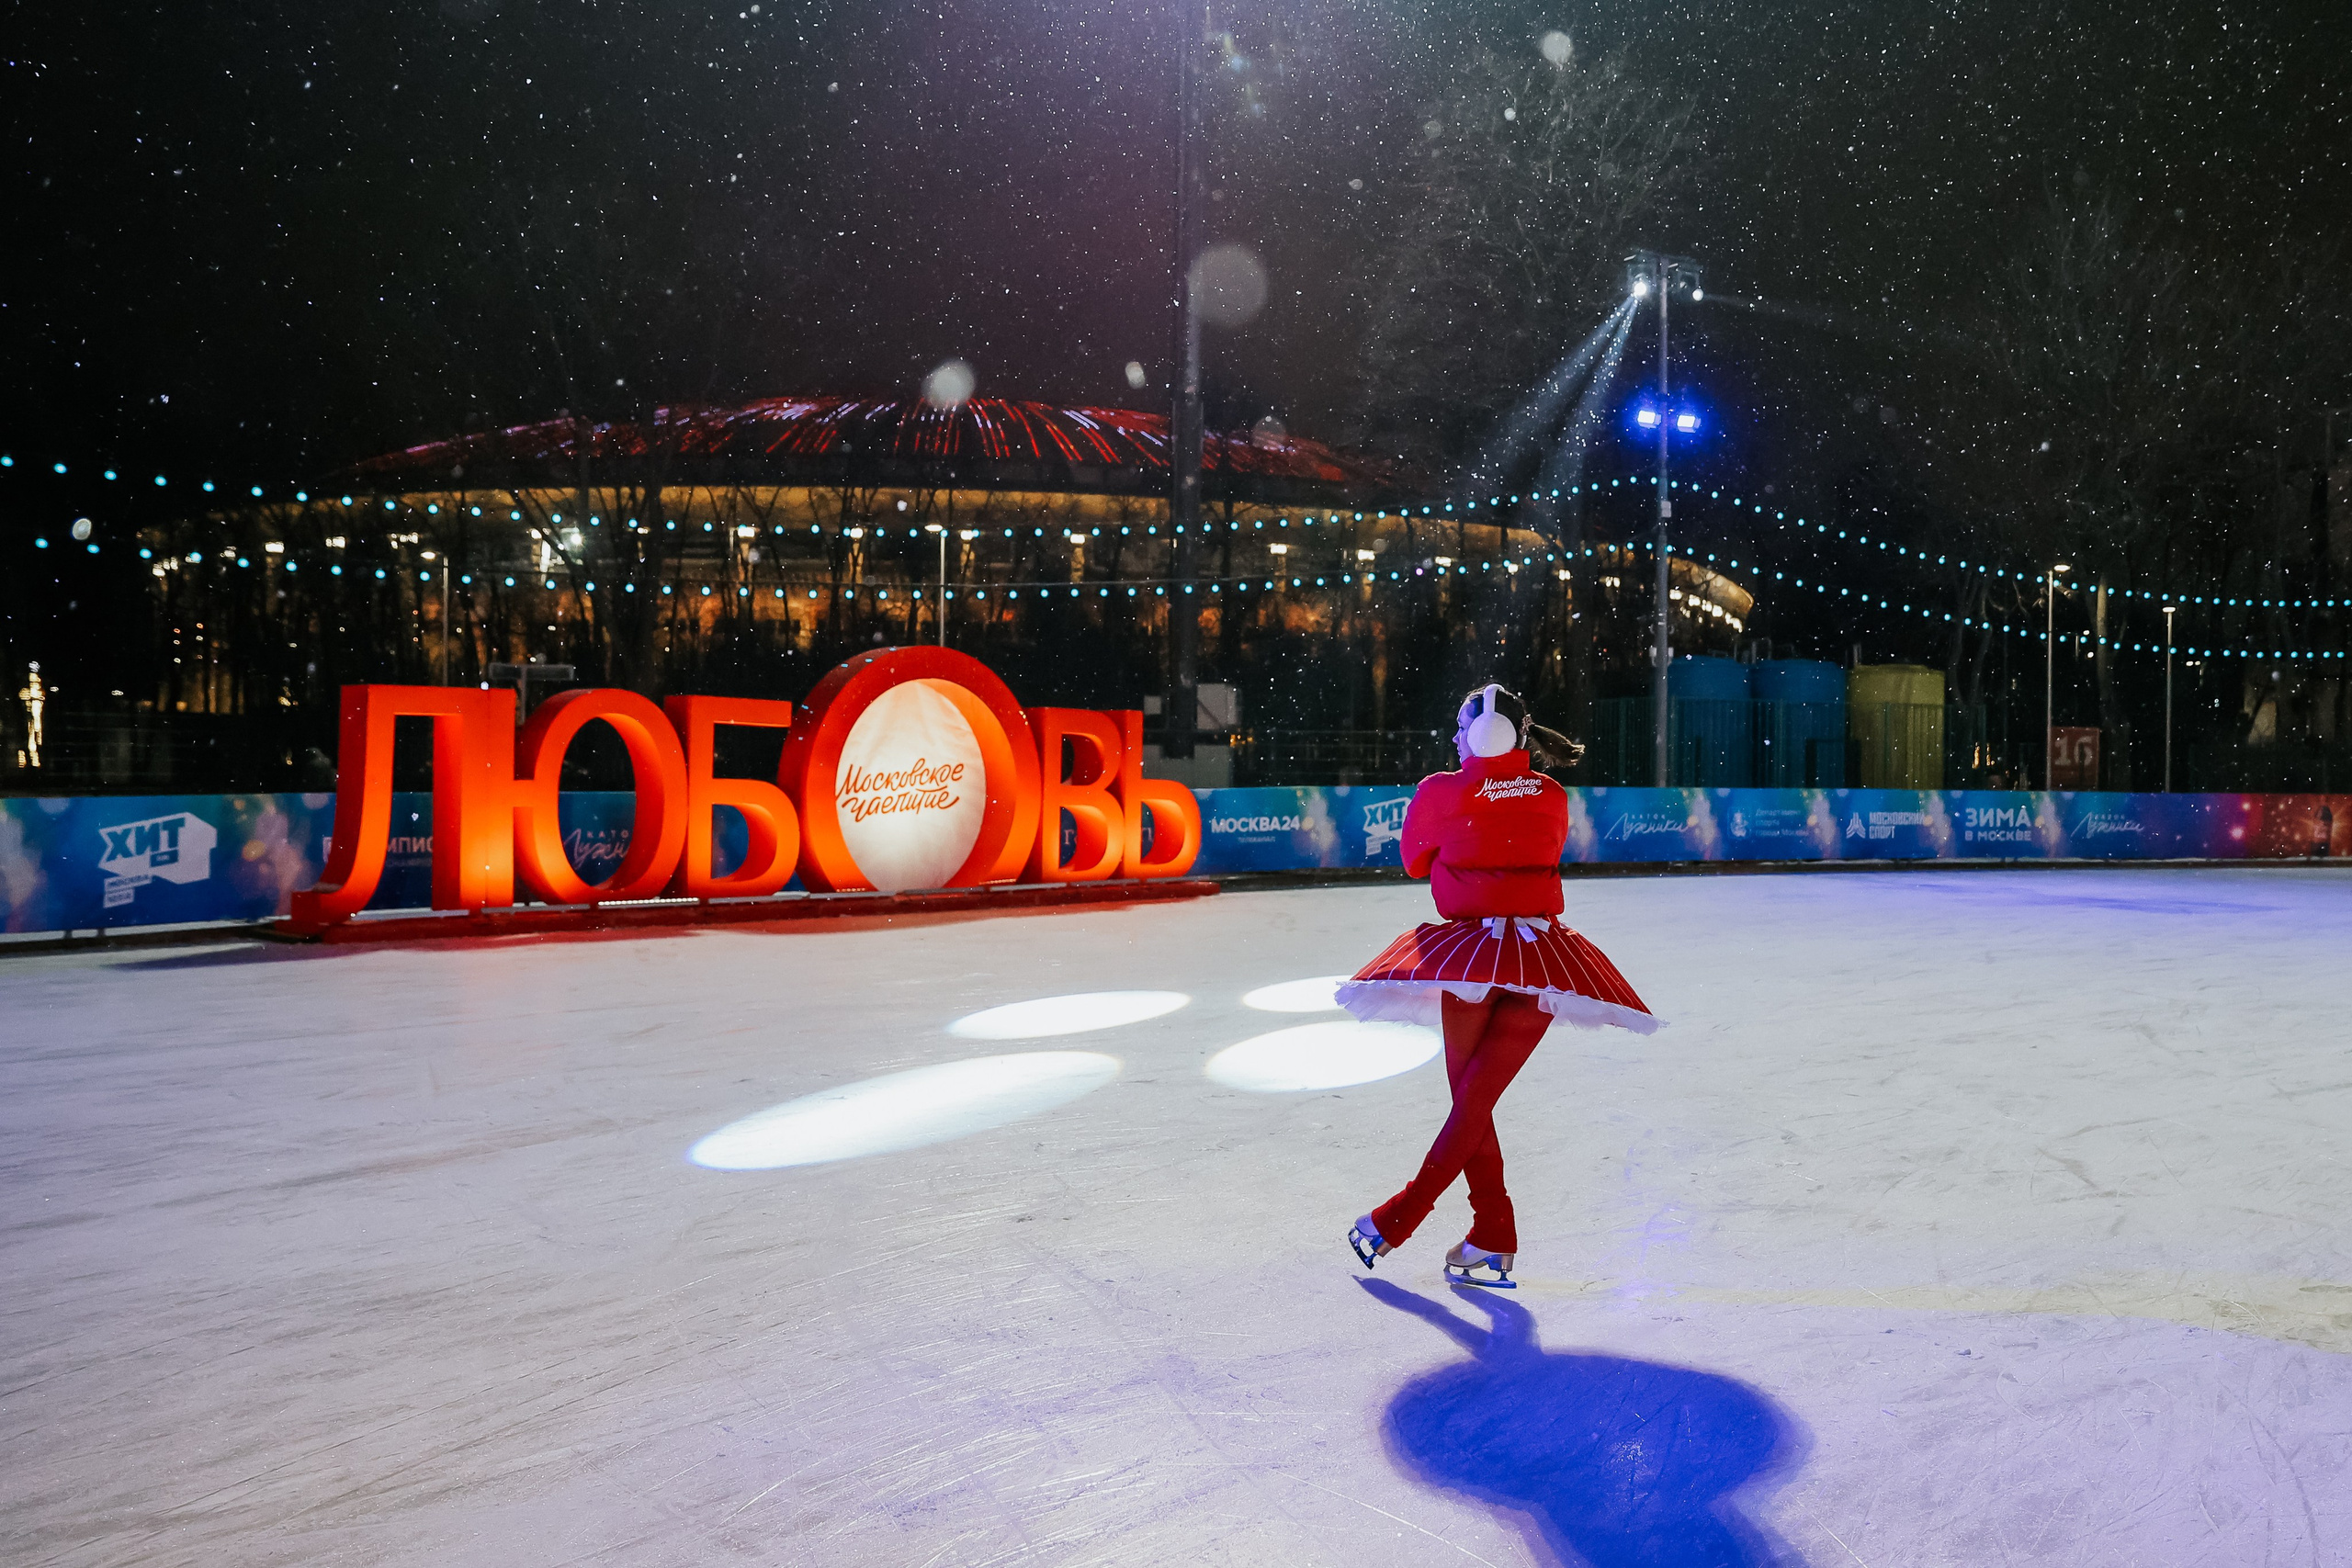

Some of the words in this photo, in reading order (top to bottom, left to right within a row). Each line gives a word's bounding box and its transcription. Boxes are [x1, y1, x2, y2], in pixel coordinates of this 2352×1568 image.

[292, 645, 1202, 919] ЛЮБОВЬ
[836, 758, 964, 801] Московское
[1475, 776, 1542, 797] Московское
[1211, 815, 1300, 833] МОСКВА24
[1367, 801, 1406, 827] ХИТ
[1964, 807, 2031, 827] ЗИМА
[105, 817, 186, 863] ХИТ
[587, 829, 630, 838] КАТО
[1977, 830, 2031, 841] МОСКВЕ
